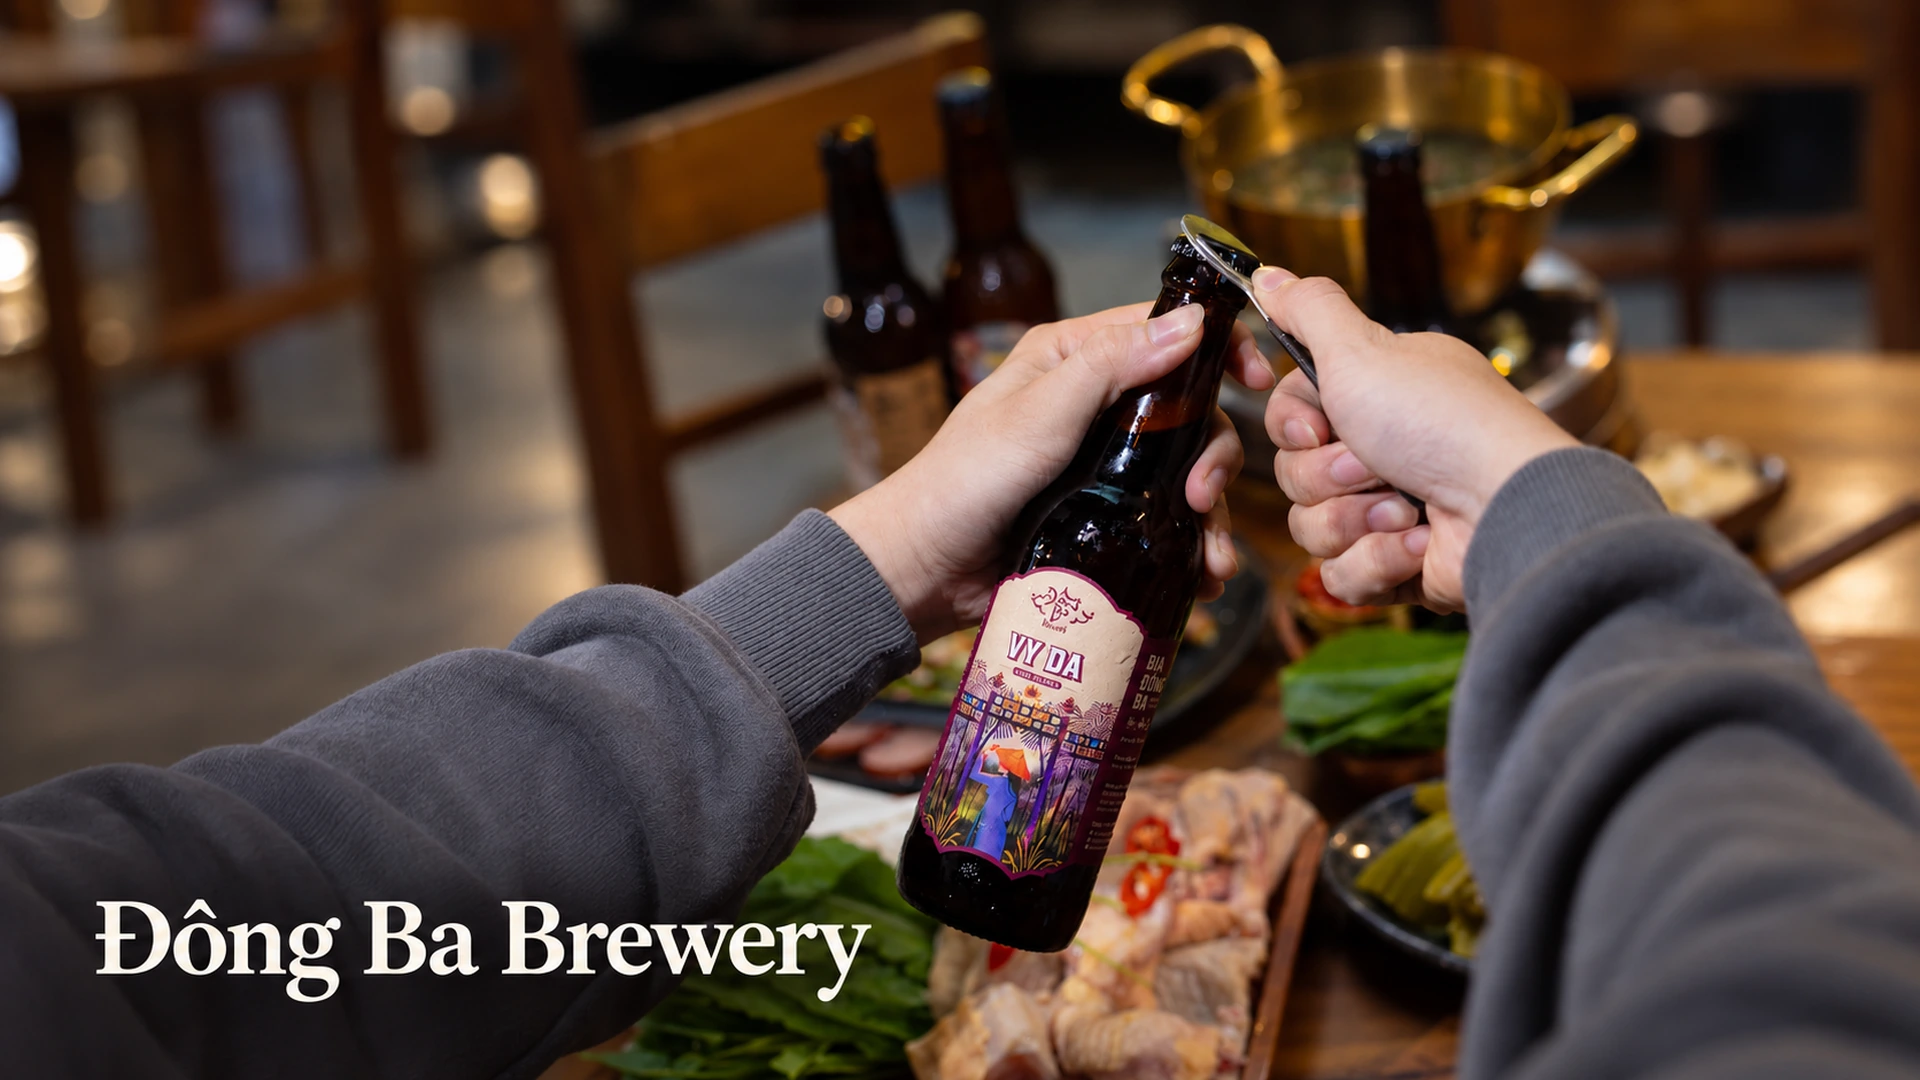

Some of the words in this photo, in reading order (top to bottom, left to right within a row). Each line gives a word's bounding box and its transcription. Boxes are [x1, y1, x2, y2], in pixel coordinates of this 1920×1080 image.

[1007, 631, 1046, 667] VY
[1043, 645, 1085, 683] DA
[1146, 654, 1165, 672] BIA
[1132, 693, 1148, 711] BA
